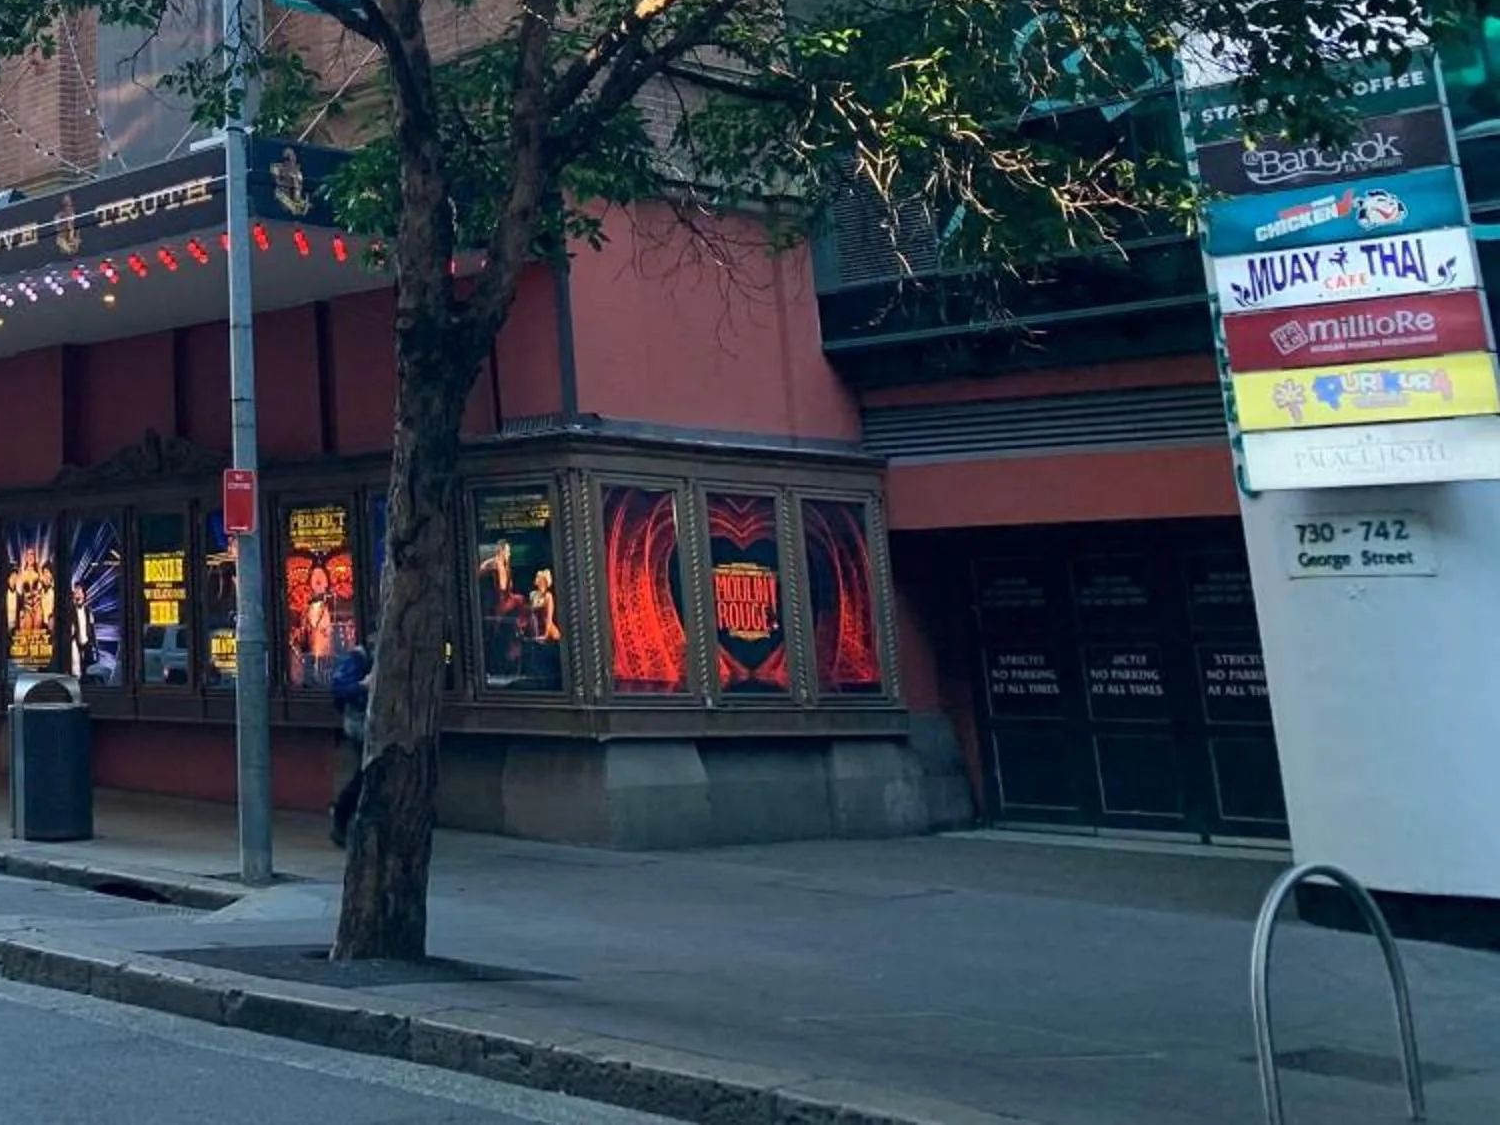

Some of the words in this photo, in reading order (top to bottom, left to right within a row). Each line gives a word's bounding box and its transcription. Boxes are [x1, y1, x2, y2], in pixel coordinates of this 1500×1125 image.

[95, 176, 213, 227] TRUTH
[1247, 250, 1321, 303] MUAY
[1359, 238, 1429, 283] THAI
[1324, 272, 1369, 291] CAFE
[1308, 310, 1435, 342] millioRe
[1294, 522, 1336, 545] 730
[1358, 519, 1411, 542] 742
[1298, 552, 1351, 570] George
[1361, 549, 1414, 566] Street
[715, 574, 769, 605] MOULIN
[1212, 653, 1263, 666] STRICTL
